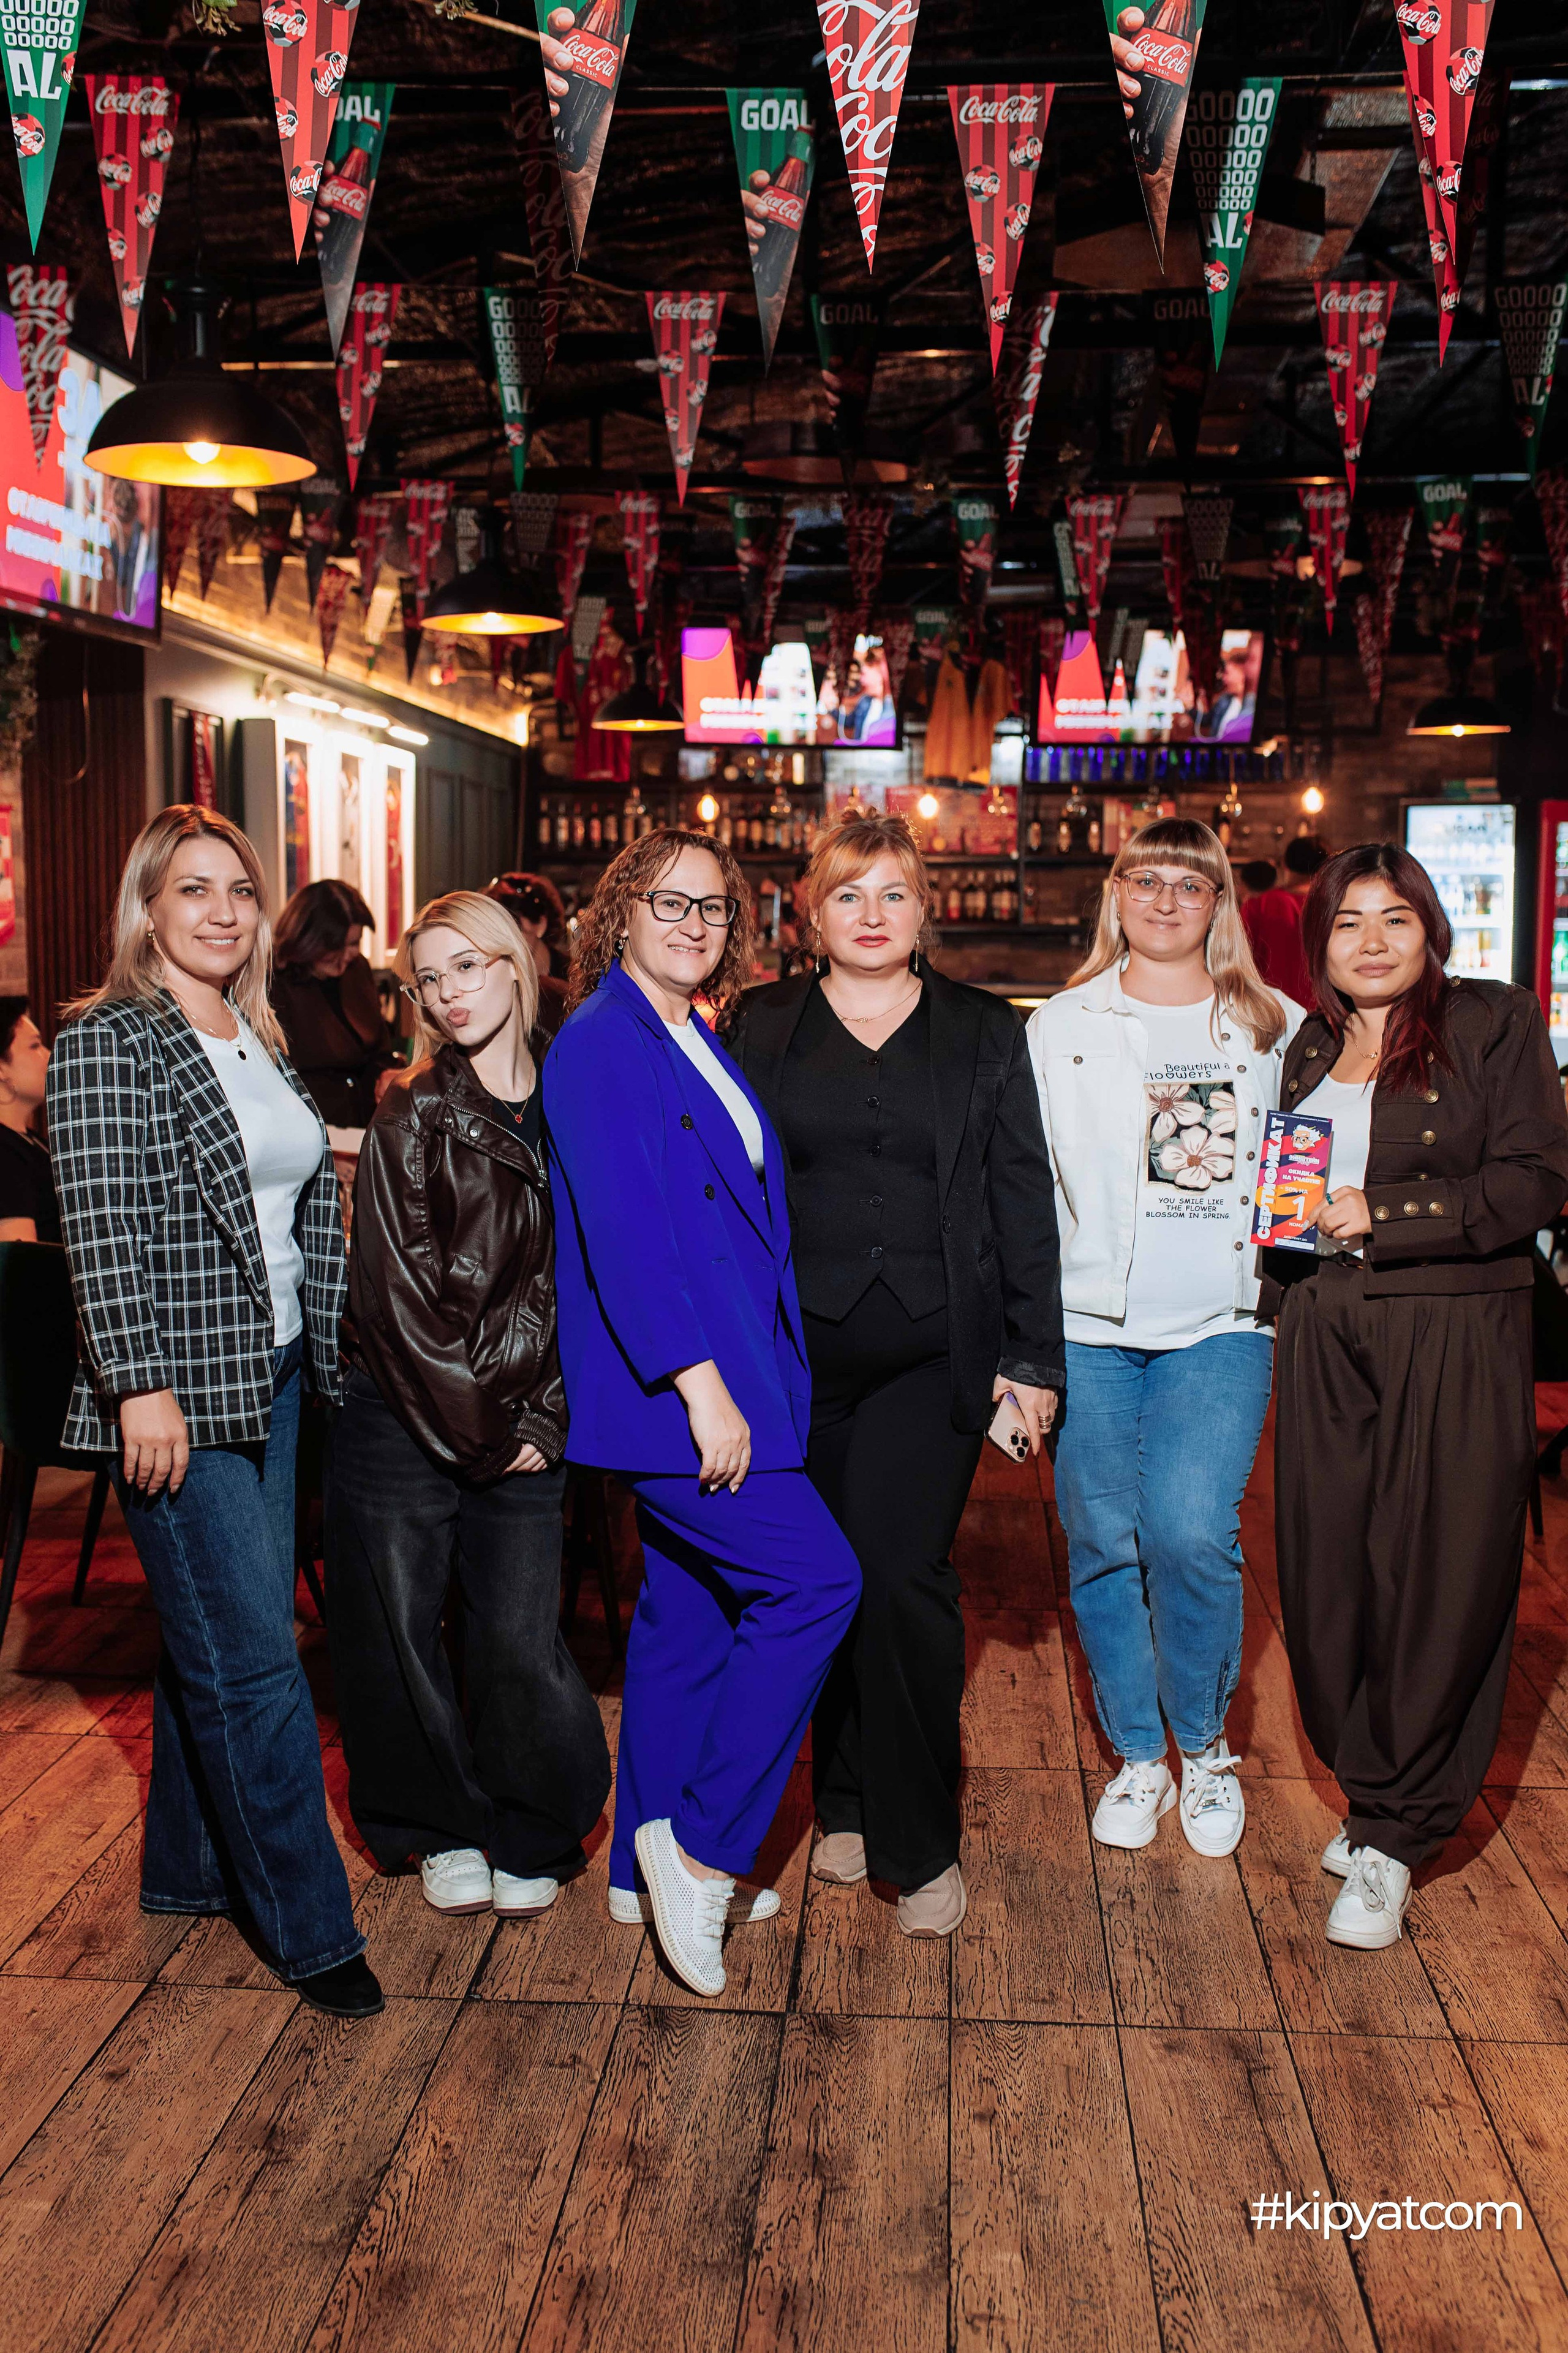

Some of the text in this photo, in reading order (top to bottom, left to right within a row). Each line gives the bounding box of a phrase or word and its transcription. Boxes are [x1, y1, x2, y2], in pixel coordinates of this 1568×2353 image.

[563, 35, 619, 77] Coca-Cola
[1133, 34, 1191, 74] Coca-Cola
[6, 49, 62, 100] AL
[576, 65, 598, 78] CLASSIC
[1147, 65, 1169, 76] CLASSIC
[741, 99, 816, 131] GOAL
[959, 96, 1044, 125] Coca-Cola
[1200, 211, 1243, 248] AL
[820, 304, 878, 325] GOAL
[1164, 1063, 1221, 1072] Beautiful
[1257, 1117, 1285, 1240] СЕРТИФИКАТ
[1288, 1168, 1315, 1177] СКИДКА
[1292, 1196, 1305, 1220] 1
